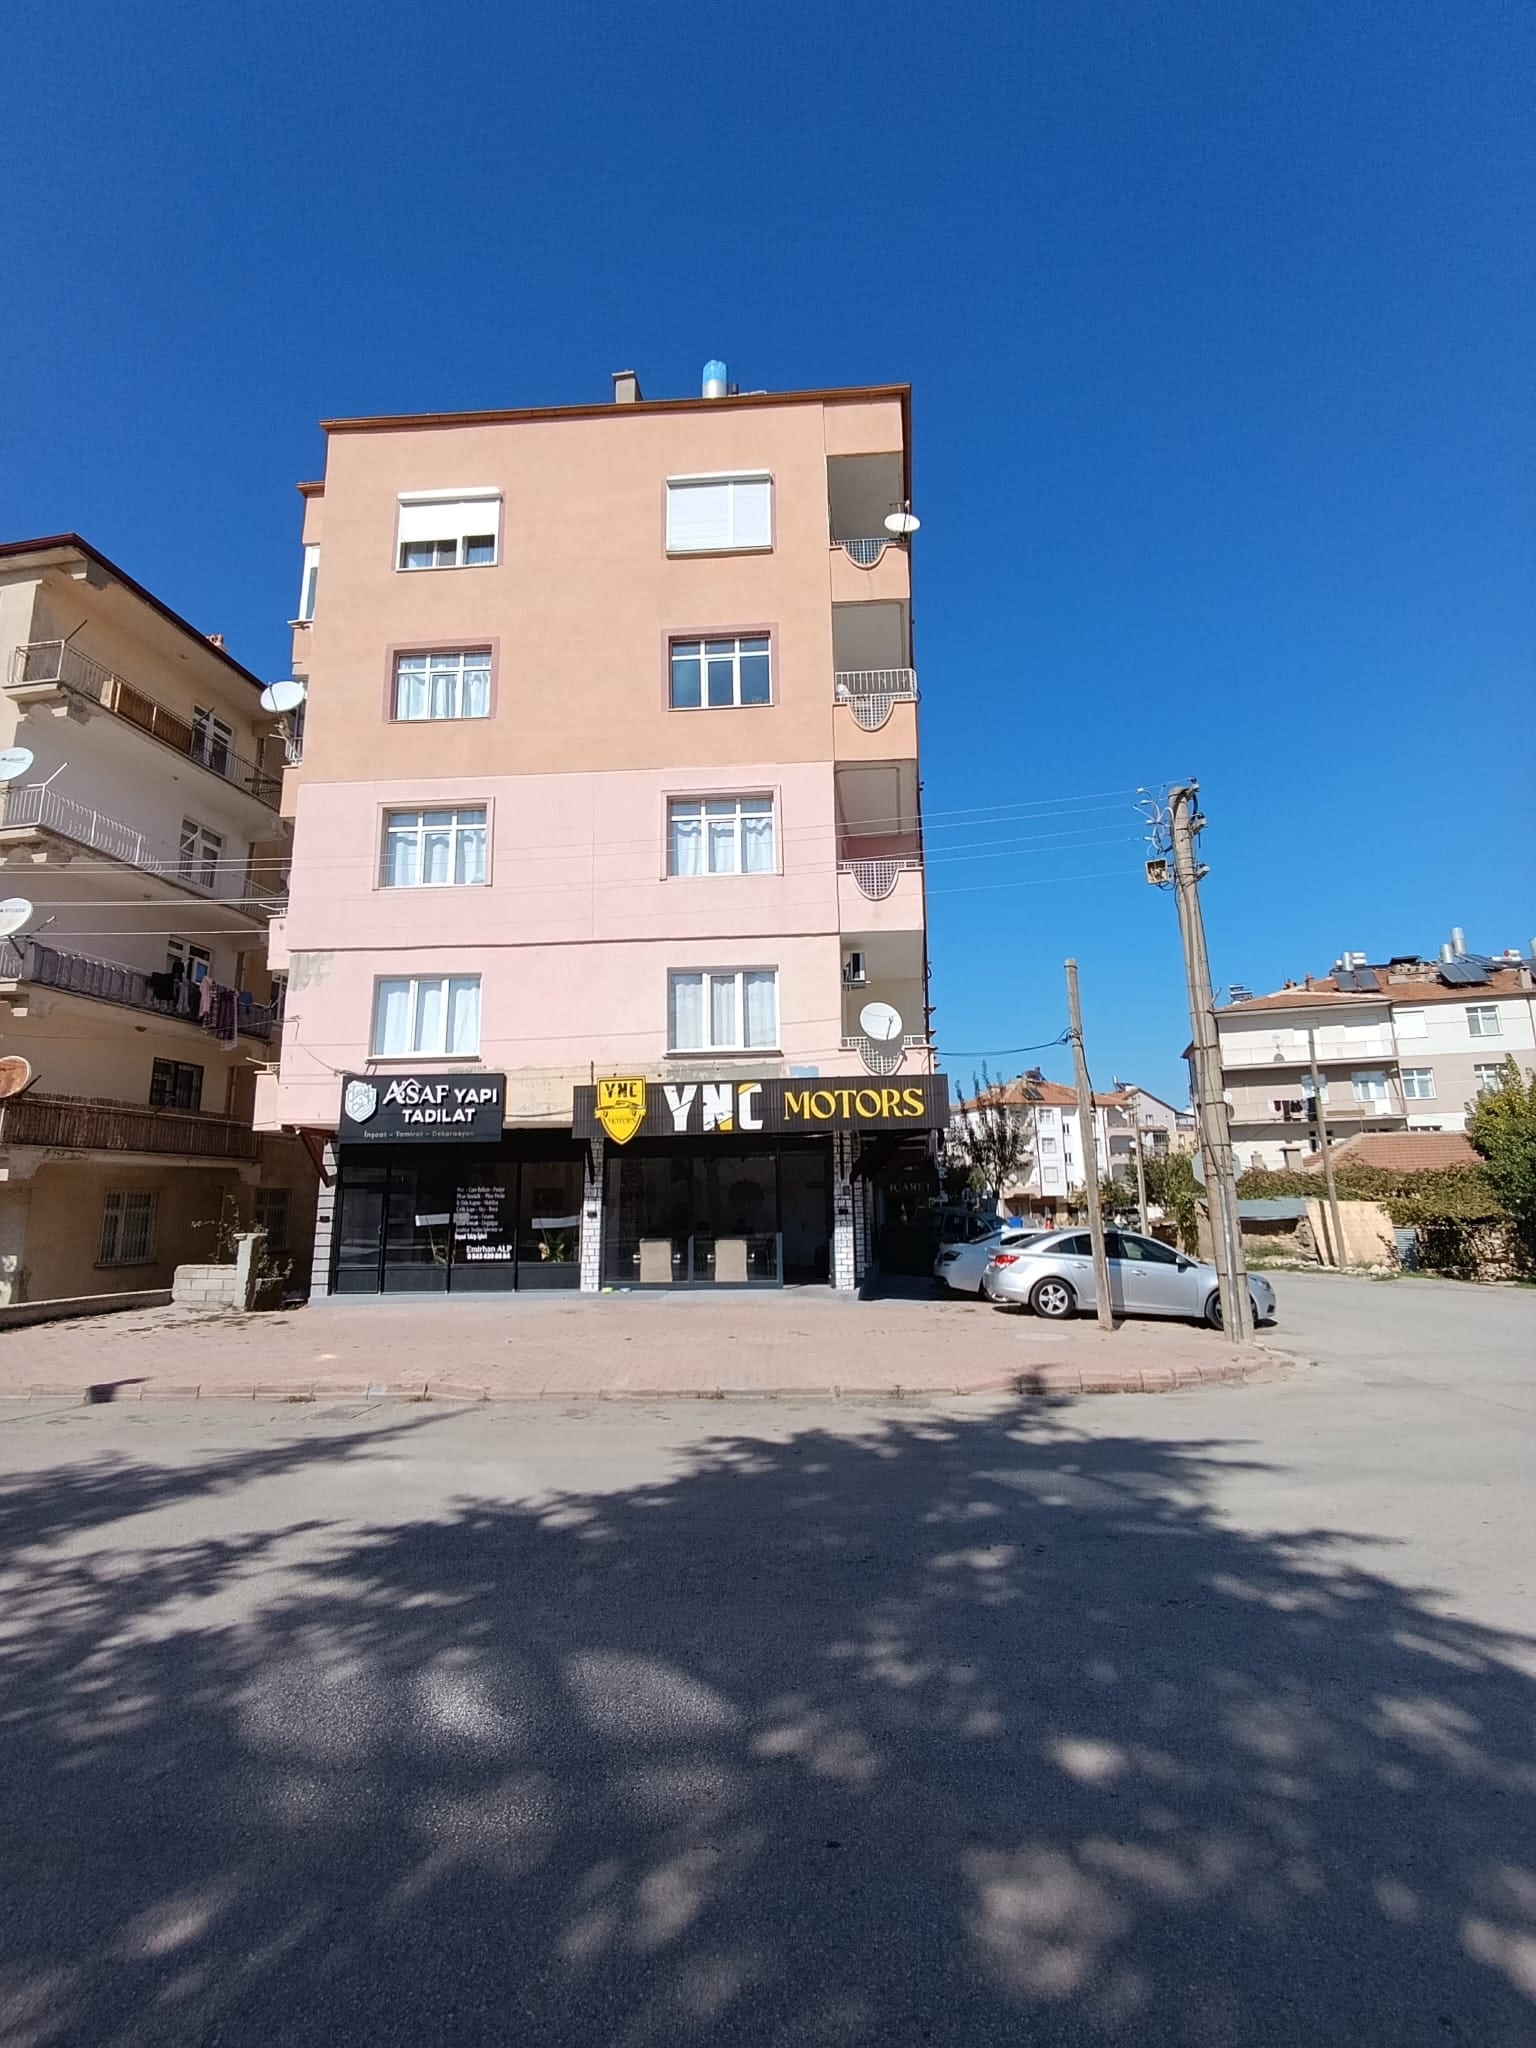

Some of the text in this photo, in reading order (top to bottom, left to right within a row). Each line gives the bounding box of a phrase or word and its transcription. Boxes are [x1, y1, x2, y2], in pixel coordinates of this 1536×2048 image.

[454, 1087, 498, 1104] YAPI
[663, 1082, 925, 1132] YNC MOTORS
[466, 1244, 513, 1253] Emirhan ALP
